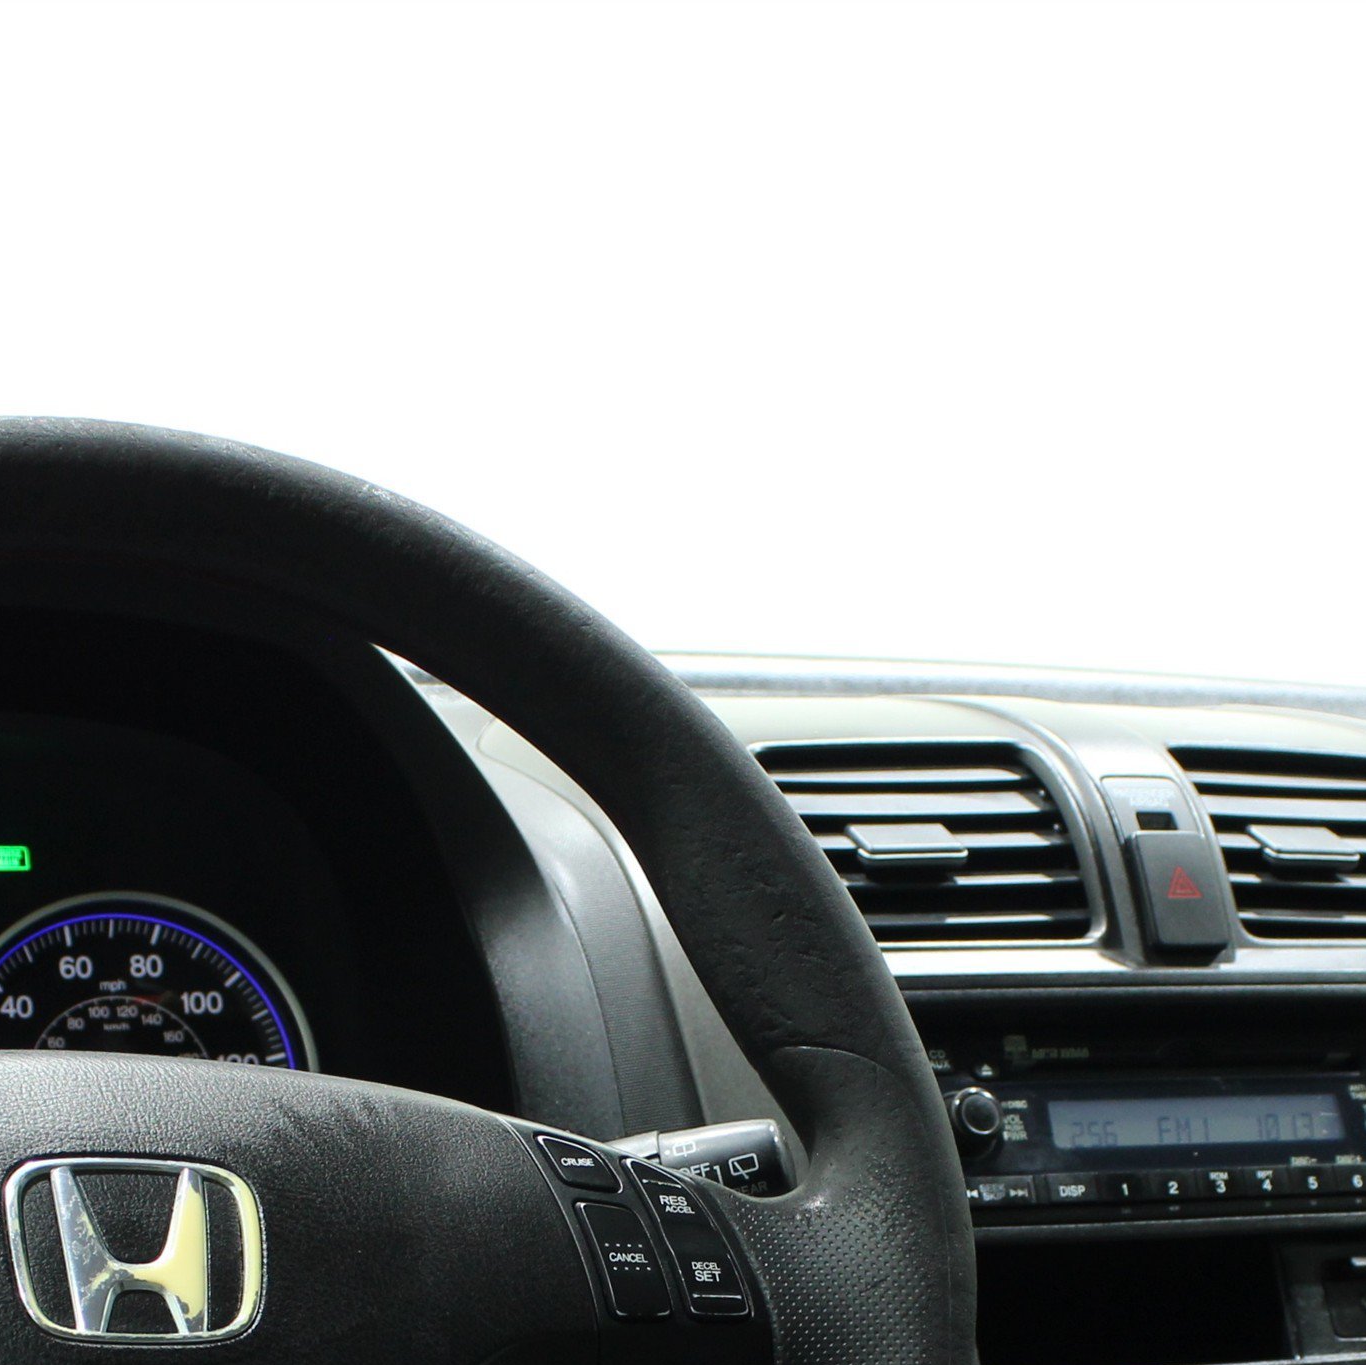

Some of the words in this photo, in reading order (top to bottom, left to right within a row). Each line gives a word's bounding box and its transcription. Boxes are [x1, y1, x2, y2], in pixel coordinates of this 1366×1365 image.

[58, 955, 94, 980] 60
[129, 954, 164, 979] 80
[99, 980, 128, 992] mph
[0, 994, 34, 1020] 40
[179, 991, 224, 1015] 100
[88, 1005, 111, 1019] 100
[116, 1005, 139, 1018] 120
[561, 1157, 595, 1168] CRUISE
[1168, 1181, 1180, 1195] 2
[1215, 1180, 1227, 1194] 3
[1261, 1178, 1273, 1192] 4
[1307, 1176, 1319, 1190] 5
[1351, 1174, 1364, 1188] 6
[1058, 1184, 1086, 1198] DISP
[1121, 1183, 1129, 1196] 1
[659, 1194, 688, 1207] RES
[665, 1204, 695, 1215] ACCEL
[609, 1251, 649, 1264] CANCEL
[692, 1261, 721, 1272] DECEL
[695, 1269, 722, 1283] SET
